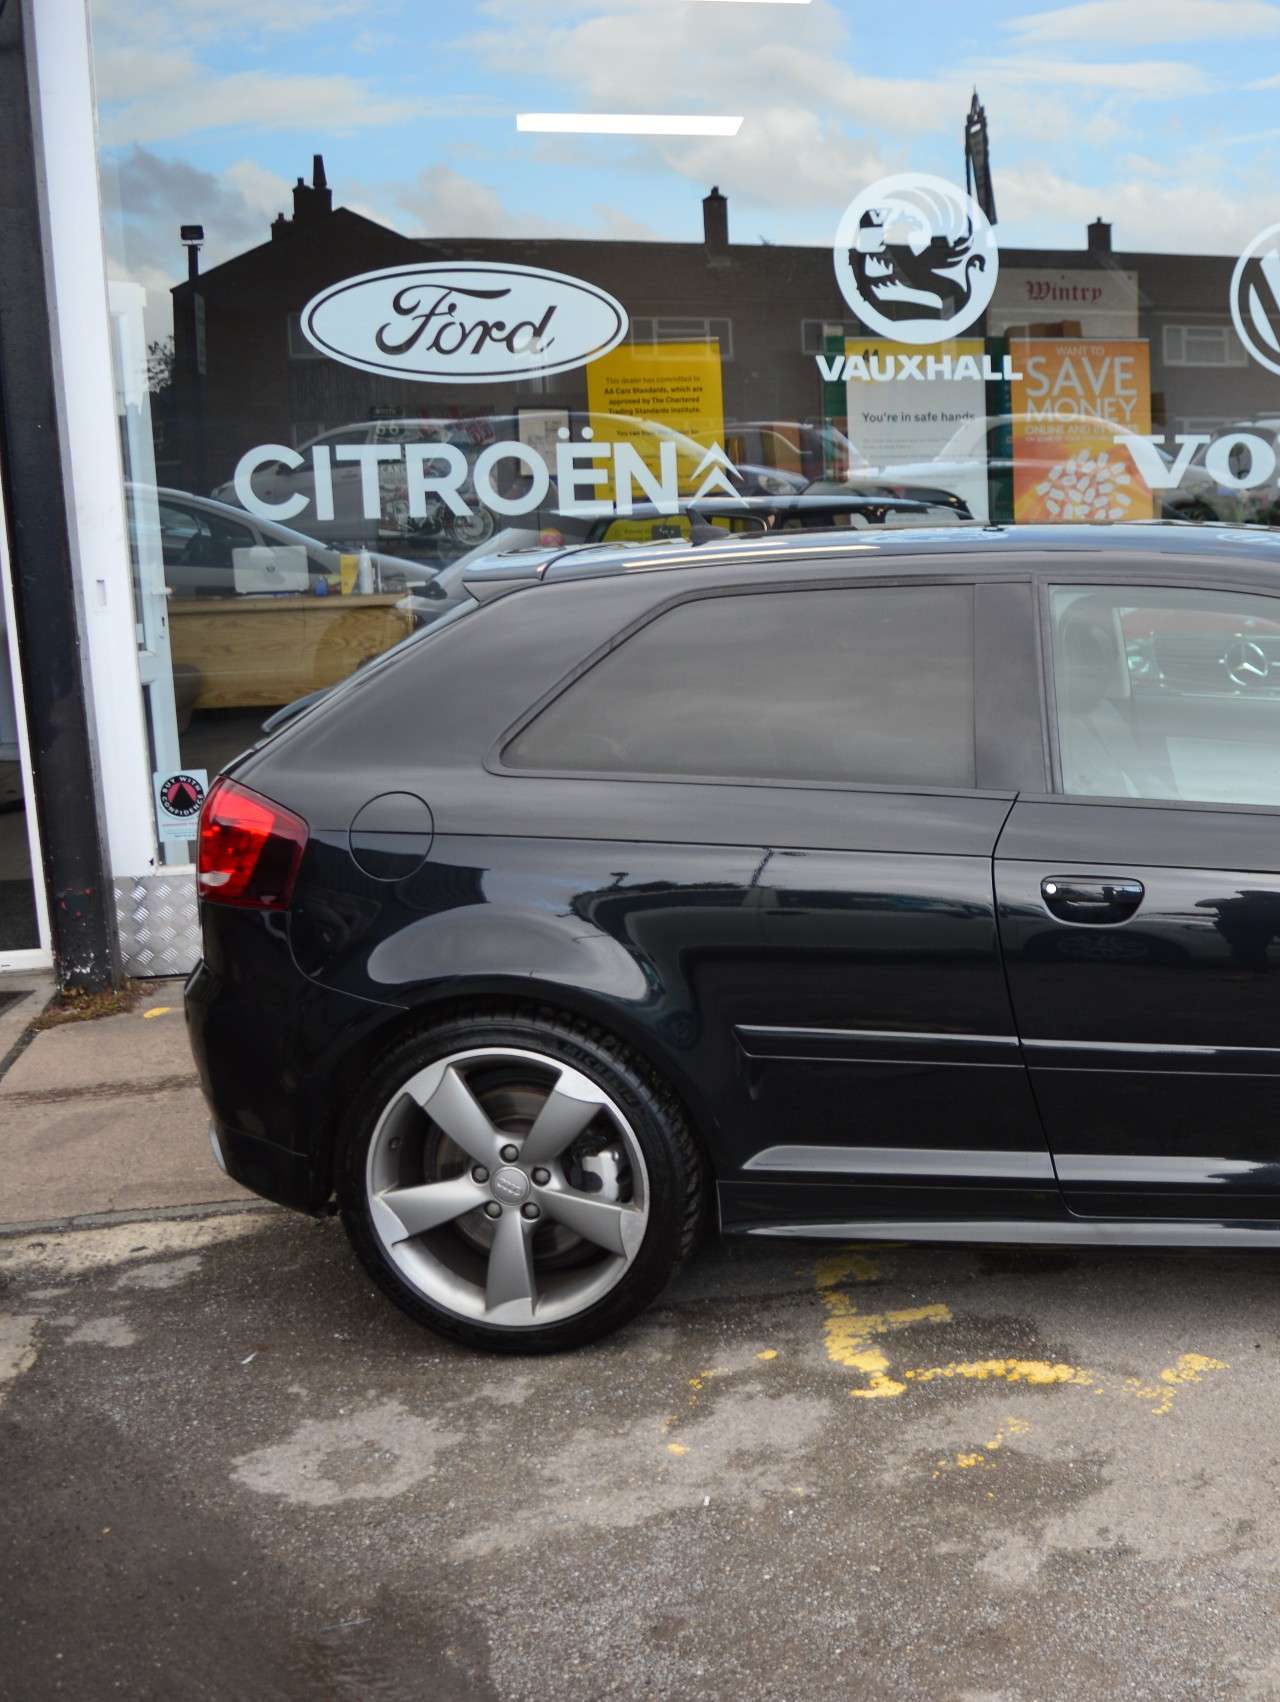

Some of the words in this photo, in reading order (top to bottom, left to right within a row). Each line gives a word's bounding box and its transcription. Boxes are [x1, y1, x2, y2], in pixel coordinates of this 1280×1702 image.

[1025, 281, 1103, 304] Wintry
[375, 284, 557, 356] Ford
[1090, 345, 1105, 355] TO
[816, 353, 1023, 382] VAUXHALL
[1025, 355, 1138, 397] SAVE
[862, 411, 899, 423] You're
[900, 412, 912, 422] in
[914, 411, 938, 422] safe
[940, 411, 976, 422] hands
[1025, 397, 1138, 422] MONEY
[232, 427, 680, 521] CITROËN
[162, 779, 176, 793] BUY
[179, 776, 202, 792] WITH
